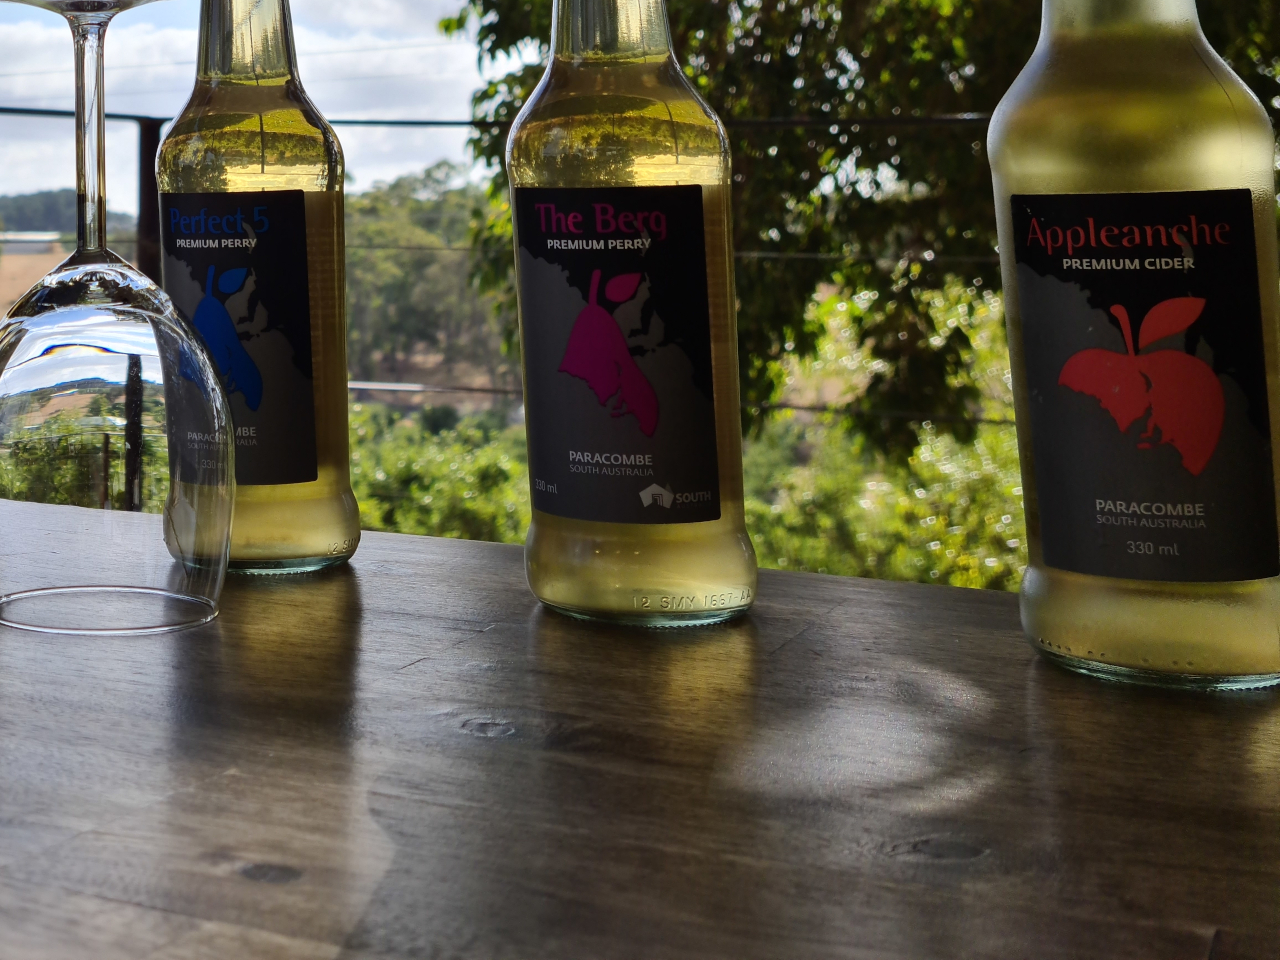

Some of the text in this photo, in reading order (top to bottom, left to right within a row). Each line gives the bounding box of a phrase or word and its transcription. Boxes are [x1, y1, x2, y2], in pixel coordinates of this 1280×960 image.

[169, 206, 270, 234] Perfect 5
[534, 203, 667, 241] The Berg
[1027, 214, 1231, 256] Appleanche
[176, 239, 257, 249] PREMIUM PERRY
[547, 239, 652, 250] PREMIUM PERRY
[1063, 257, 1195, 270] PREMIUM CIDER
[201, 458, 216, 469] 330
[569, 451, 653, 465] PARACOMBE
[569, 465, 654, 477] SOUTH AUSTRALIA
[535, 478, 558, 494] 330 ml
[675, 491, 712, 503] SOUTH
[1095, 499, 1205, 516] PARACOMBE
[1096, 514, 1207, 529] SOUTH AUSTRALIA
[1126, 541, 1179, 556] 330 ml
[633, 596, 651, 609] 12
[660, 596, 695, 609] SMY
